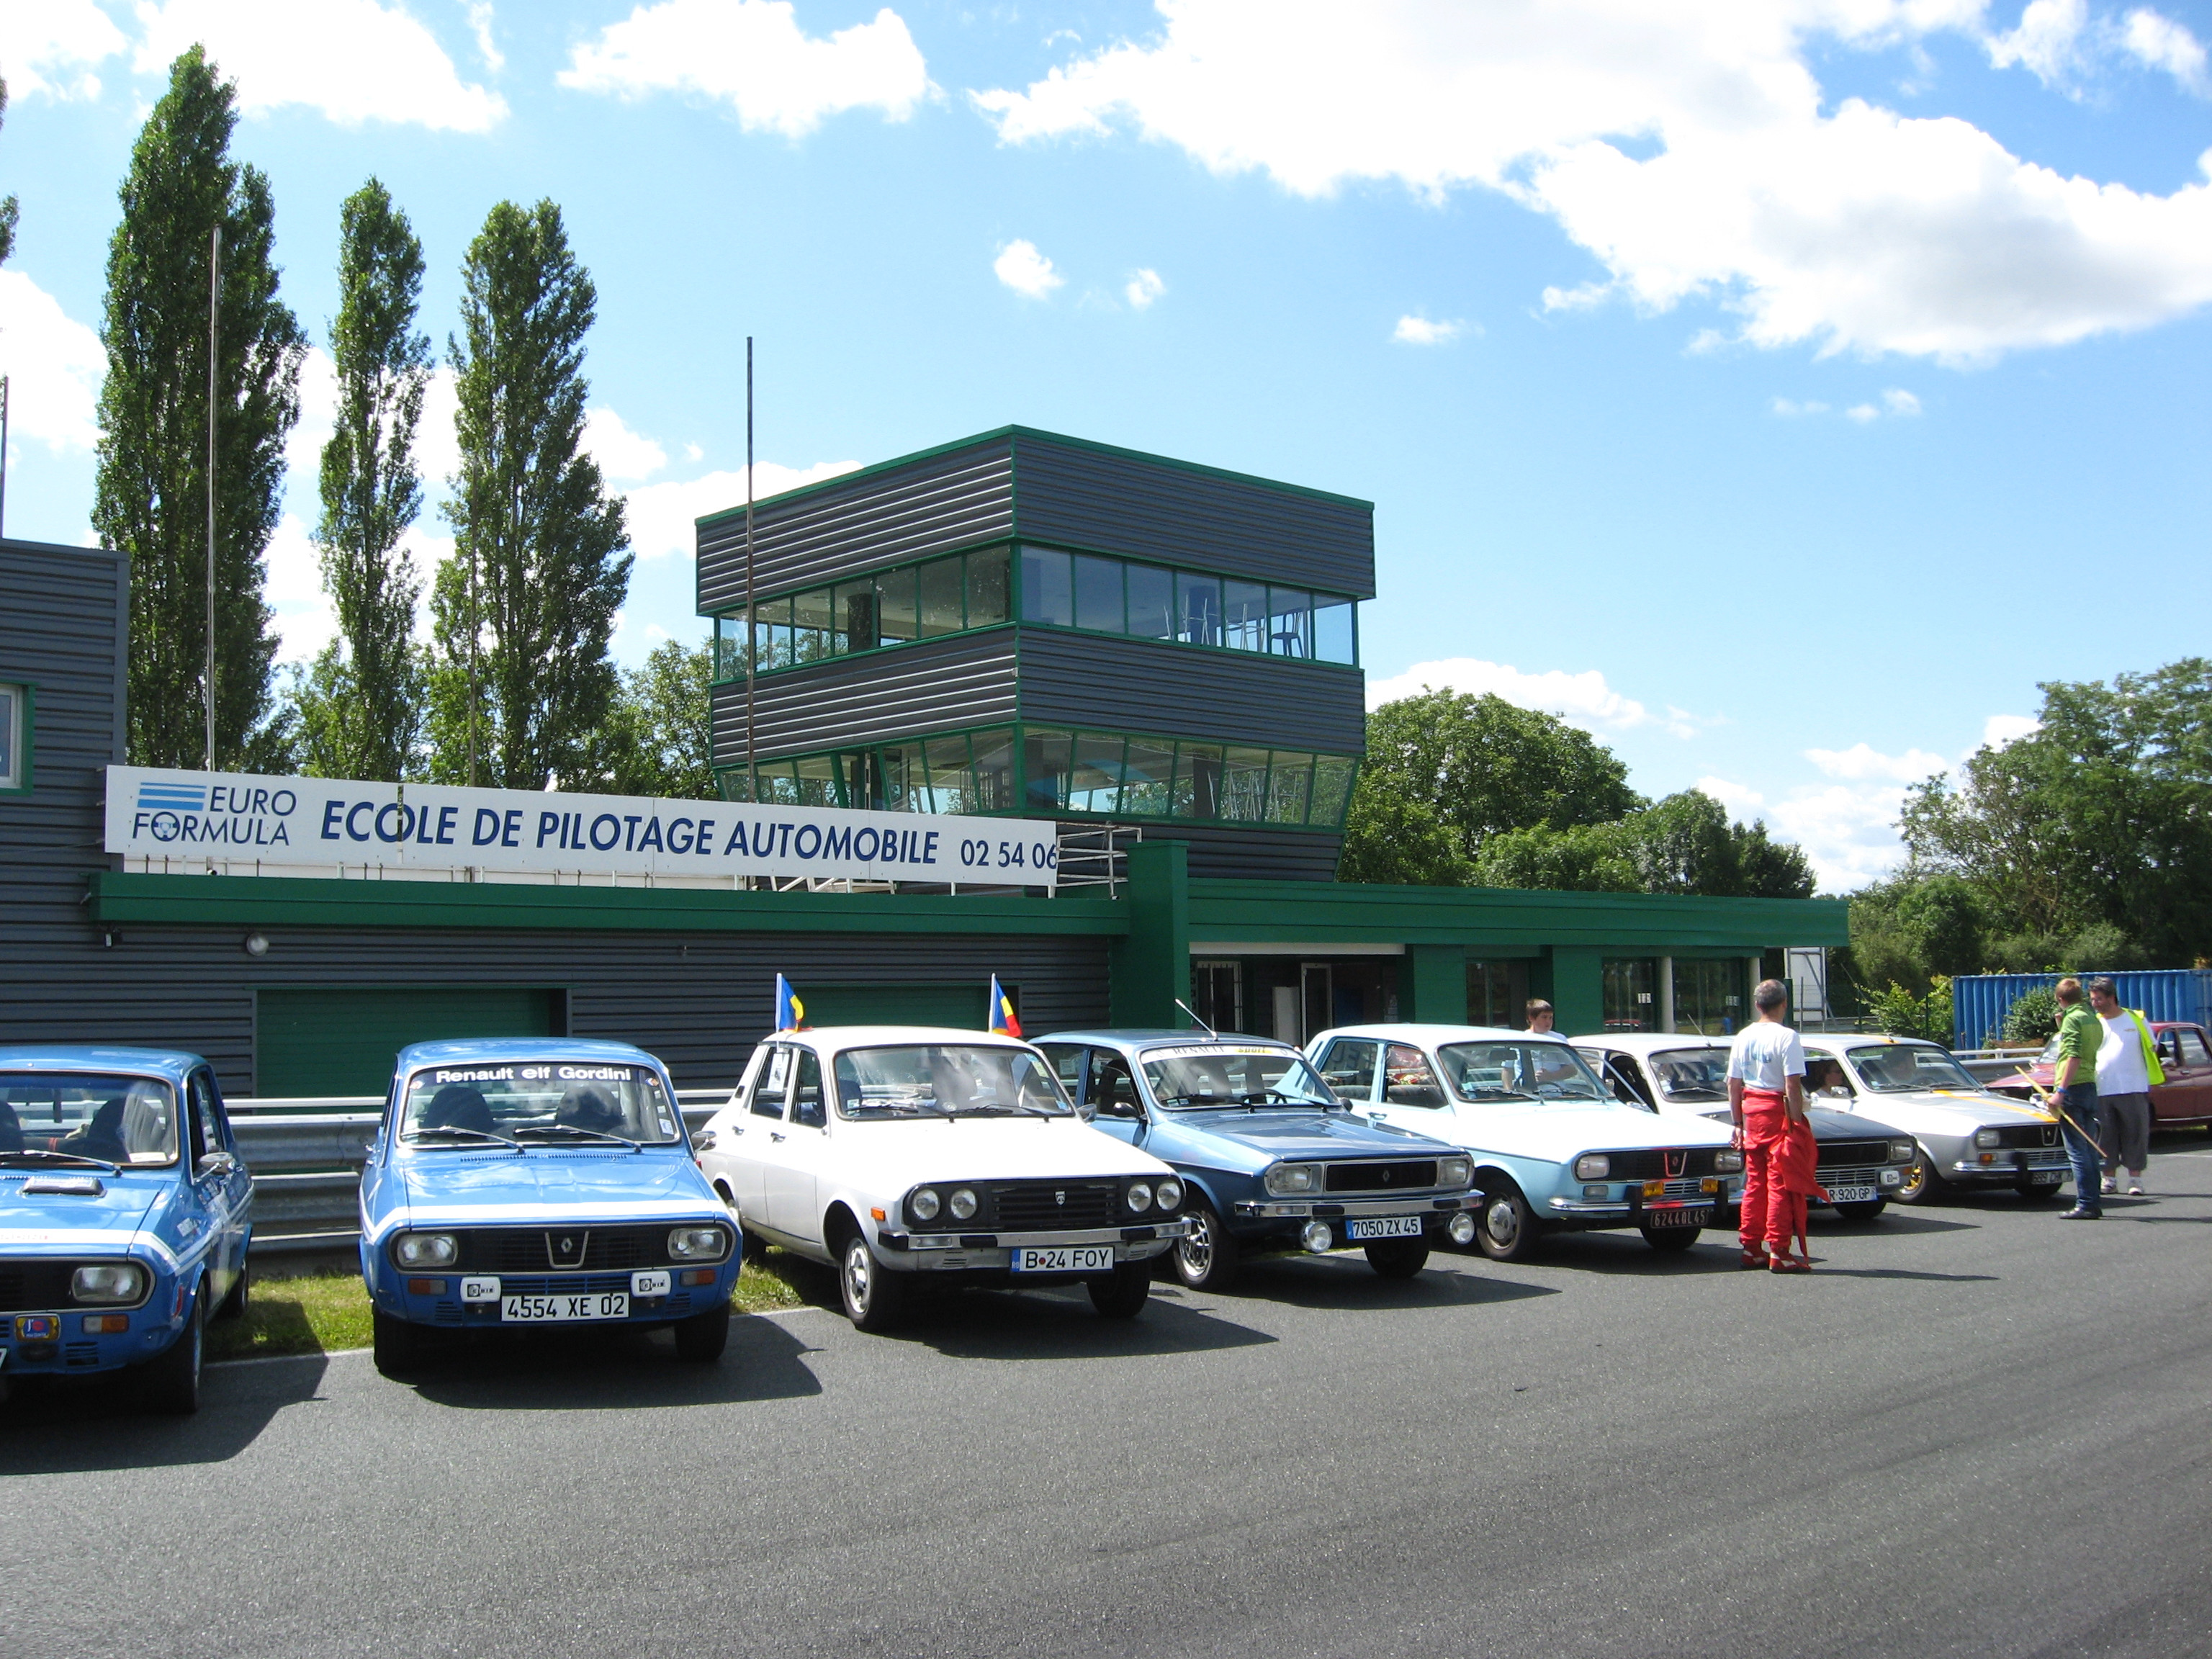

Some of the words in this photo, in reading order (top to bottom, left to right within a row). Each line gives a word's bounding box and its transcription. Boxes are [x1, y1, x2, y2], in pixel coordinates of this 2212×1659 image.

[210, 786, 297, 816] EURO
[132, 811, 289, 846] FORMULA
[320, 801, 458, 844] ECOLE
[472, 809, 523, 847] DE
[536, 811, 715, 855] PILOTAGE
[723, 821, 939, 863] AUTOMOBILE
[961, 840, 989, 866] 02
[997, 841, 1025, 868] 54
[1033, 842, 1057, 869] 06
[1173, 1046, 1224, 1056] RENAULT
[436, 1068, 513, 1083] Renault
[522, 1066, 551, 1079] elf
[558, 1066, 631, 1081] Gordini
[1353, 1220, 1384, 1237] 7050
[1387, 1219, 1401, 1235] ZX
[1404, 1218, 1418, 1233] 45
[1655, 1212, 1679, 1226] 6244
[1694, 1210, 1705, 1223] 45
[1025, 1251, 1038, 1269] B
[1046, 1251, 1066, 1268] 24
[1073, 1249, 1109, 1267] FOY
[508, 1298, 557, 1318] 4554
[568, 1297, 591, 1317] XE
[601, 1295, 624, 1315] 02
